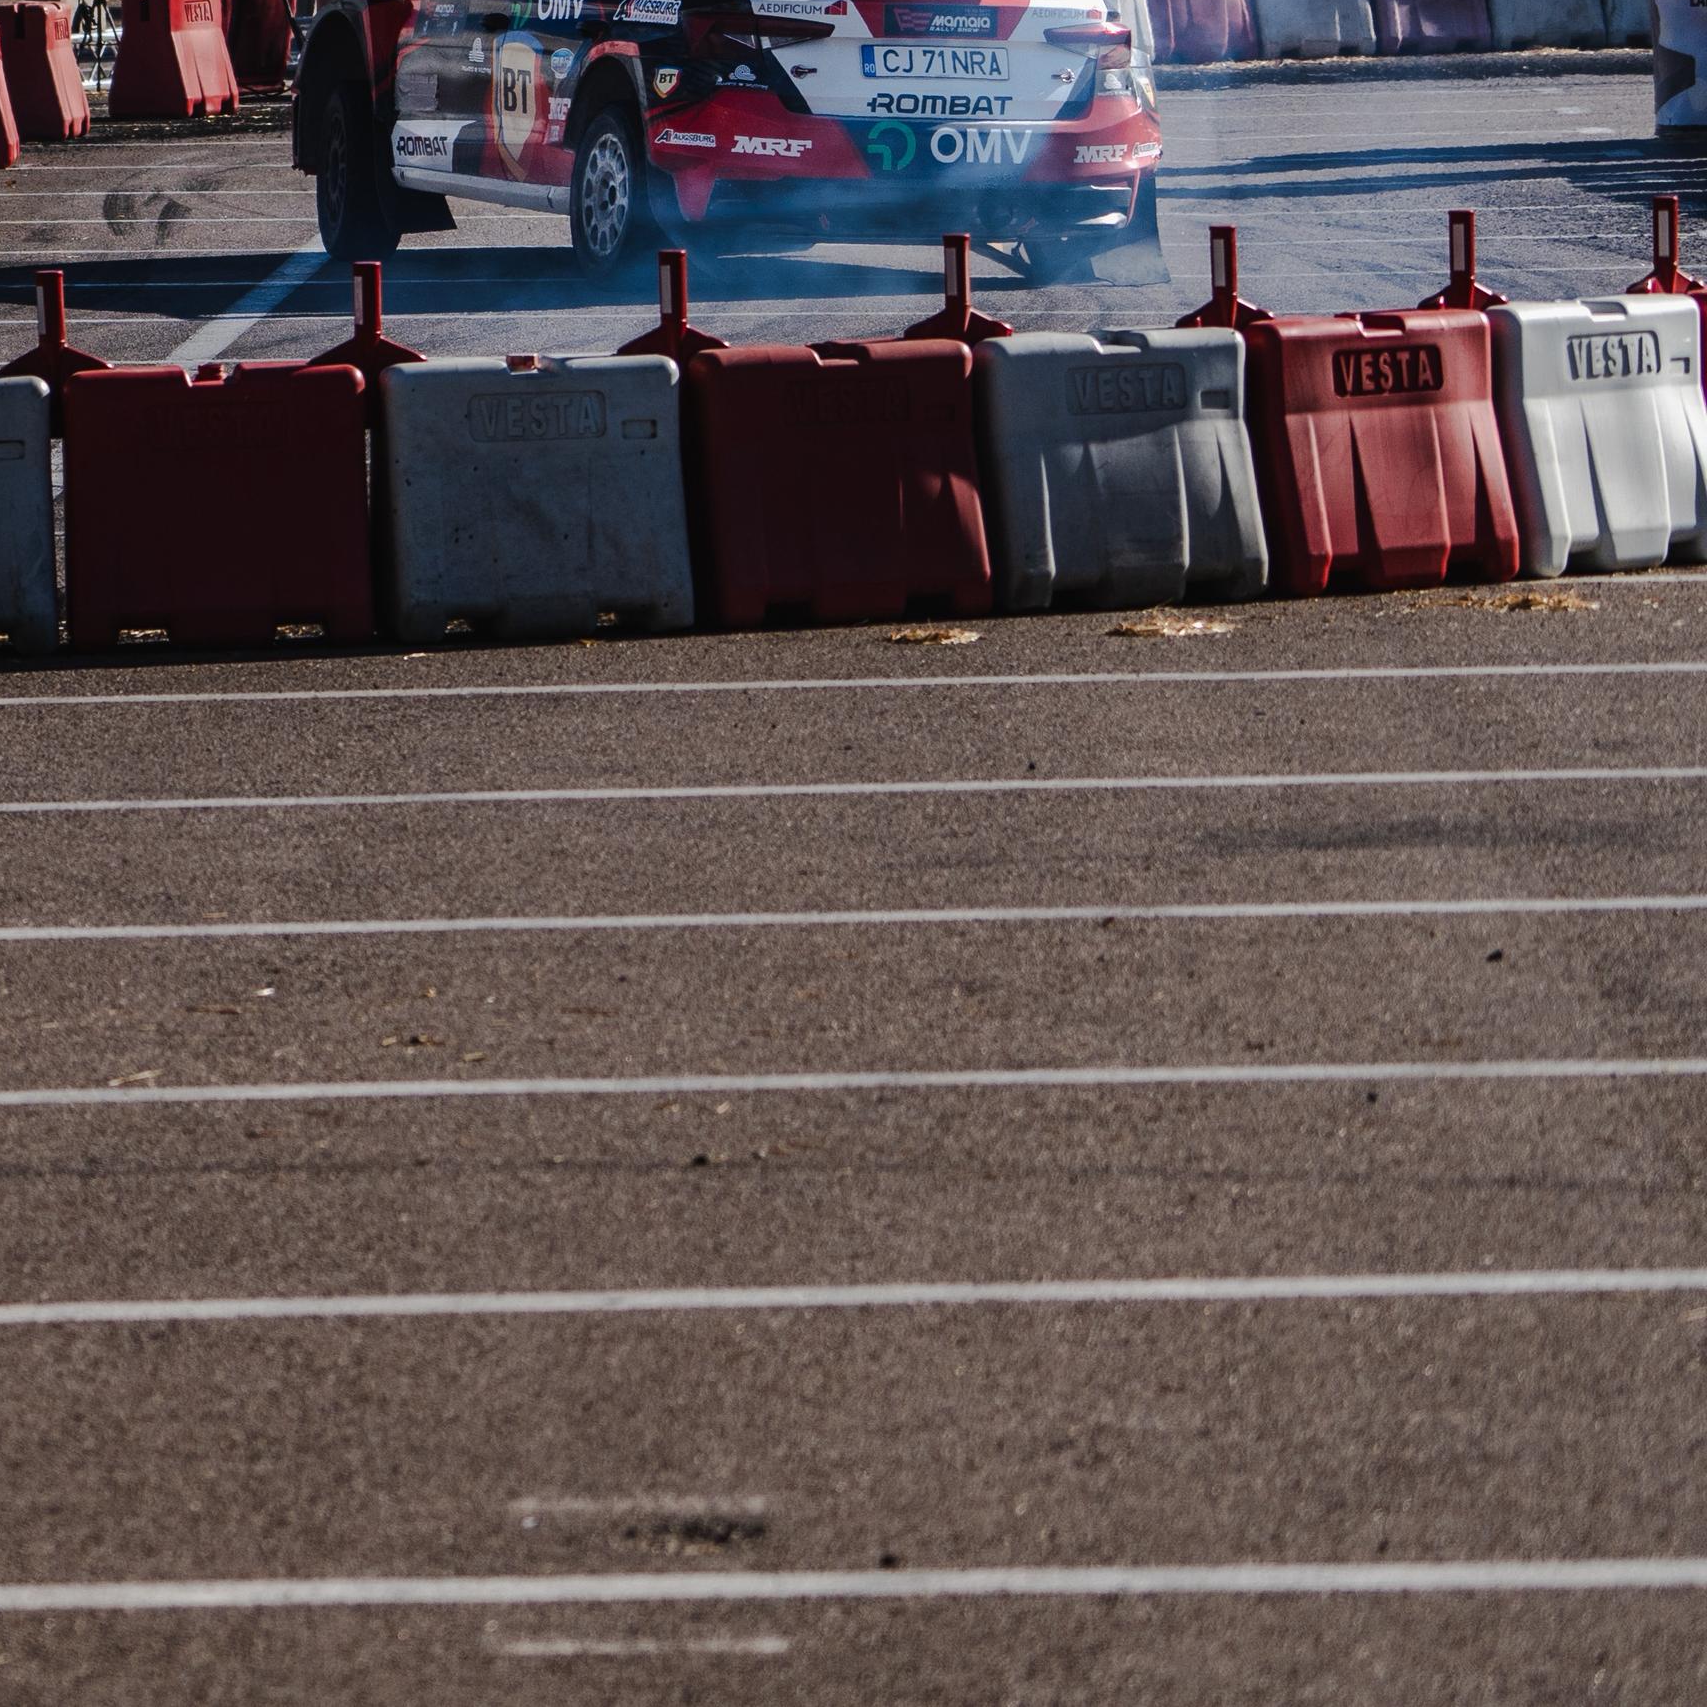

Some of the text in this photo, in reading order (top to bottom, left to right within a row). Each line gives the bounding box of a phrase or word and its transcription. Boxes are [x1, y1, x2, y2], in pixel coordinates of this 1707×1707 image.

[758, 3, 822, 14] AEDIFICIUM
[1031, 8, 1084, 19] AEDIFICIUM
[864, 64, 875, 74] RO
[883, 48, 1002, 76] CJ 71 NRA
[659, 73, 675, 84] BT
[503, 67, 531, 113] BT
[867, 93, 1013, 115] ROMBAT
[397, 136, 448, 156] ROMBAT
[673, 132, 715, 143] AUGSBURG
[731, 136, 812, 157] MRF
[930, 127, 1033, 165] OMV
[1073, 145, 1128, 164] MRF
[1571, 334, 1655, 380] VESTA
[1339, 349, 1436, 392] VESTA
[1072, 368, 1181, 411] VESTA
[477, 396, 599, 439] VESTA
